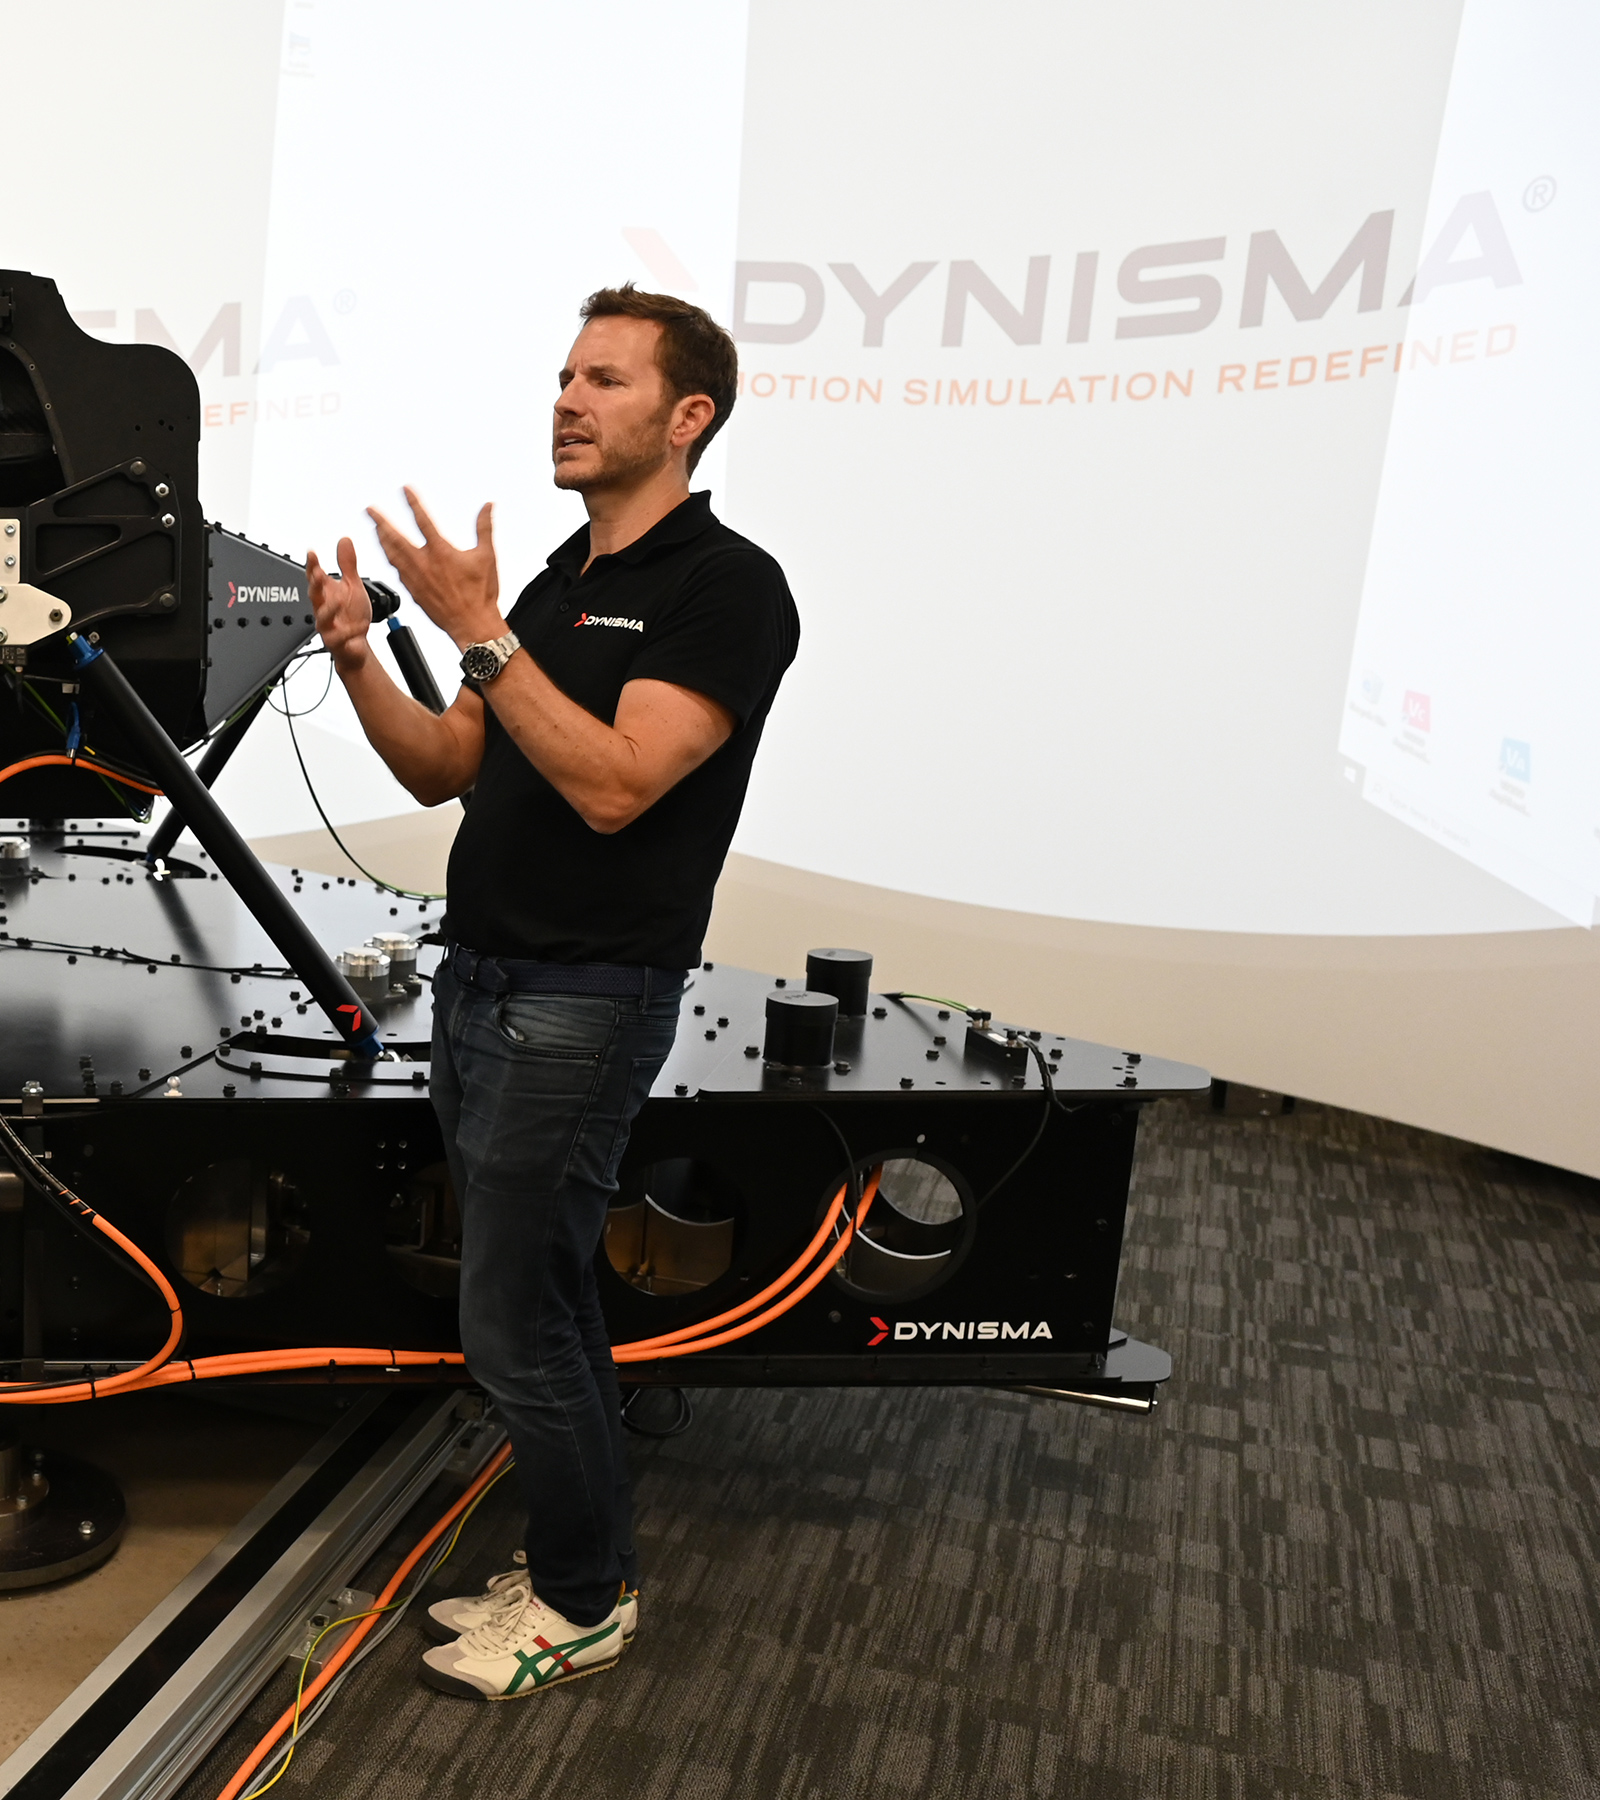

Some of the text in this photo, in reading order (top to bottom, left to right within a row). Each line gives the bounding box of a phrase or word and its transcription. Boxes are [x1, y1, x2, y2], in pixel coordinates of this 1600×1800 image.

[738, 323, 1518, 406] OTION SIMULATION REDEFINED
[204, 391, 342, 428] EFINED
[237, 586, 300, 603] DYNISMA
[583, 615, 644, 633] DYNISMA
[894, 1321, 1053, 1341] DYNISMA
